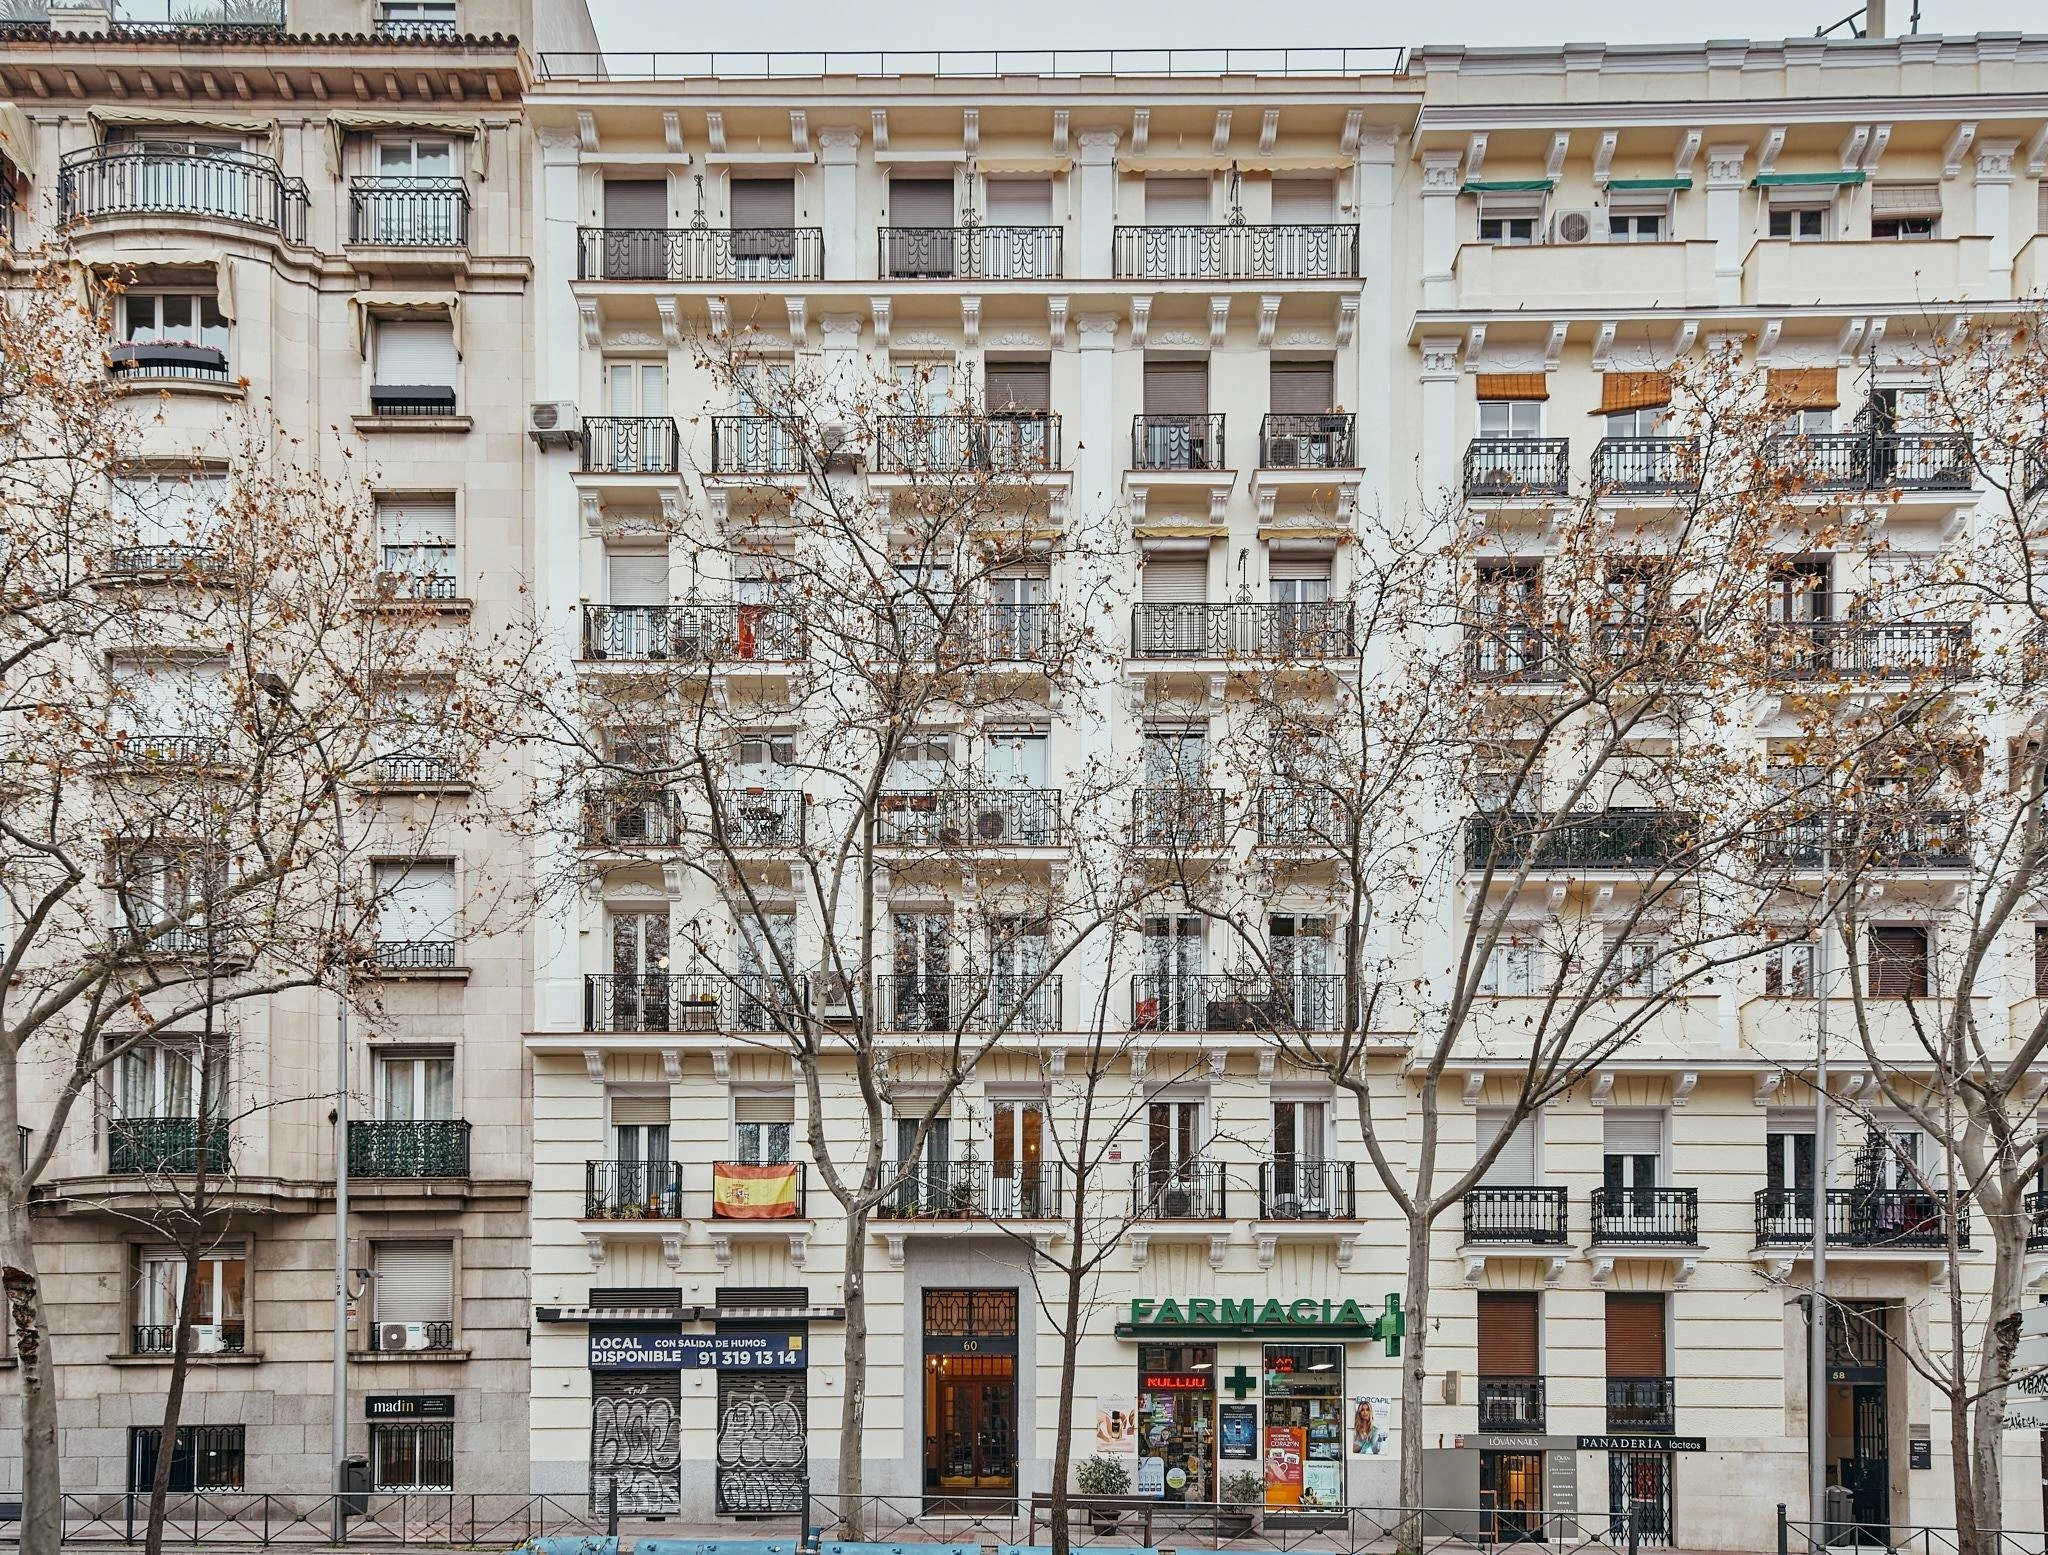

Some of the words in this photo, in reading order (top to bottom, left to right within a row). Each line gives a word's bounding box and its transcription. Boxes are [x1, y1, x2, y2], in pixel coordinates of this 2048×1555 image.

[1131, 1298, 1367, 1325] FARMACIA
[591, 1338, 642, 1349] LOCAL
[655, 1339, 677, 1348] CON
[678, 1339, 713, 1348] SALIDA
[715, 1339, 729, 1348] DE
[731, 1339, 767, 1348] HUMOS
[963, 1340, 978, 1351] 60
[591, 1350, 682, 1363] DISPONIBLE
[698, 1351, 717, 1365] 91
[721, 1351, 751, 1365] 319
[755, 1351, 773, 1365] 13
[778, 1351, 797, 1365] 14
[1832, 1371, 1846, 1380] 58
[1356, 1396, 1391, 1404] FORCAPIL
[373, 1399, 414, 1413] madin
[1517, 1437, 1539, 1446] NAILS
[1582, 1438, 1662, 1449] PANADERÍA
[1669, 1440, 1701, 1450] lácteos
